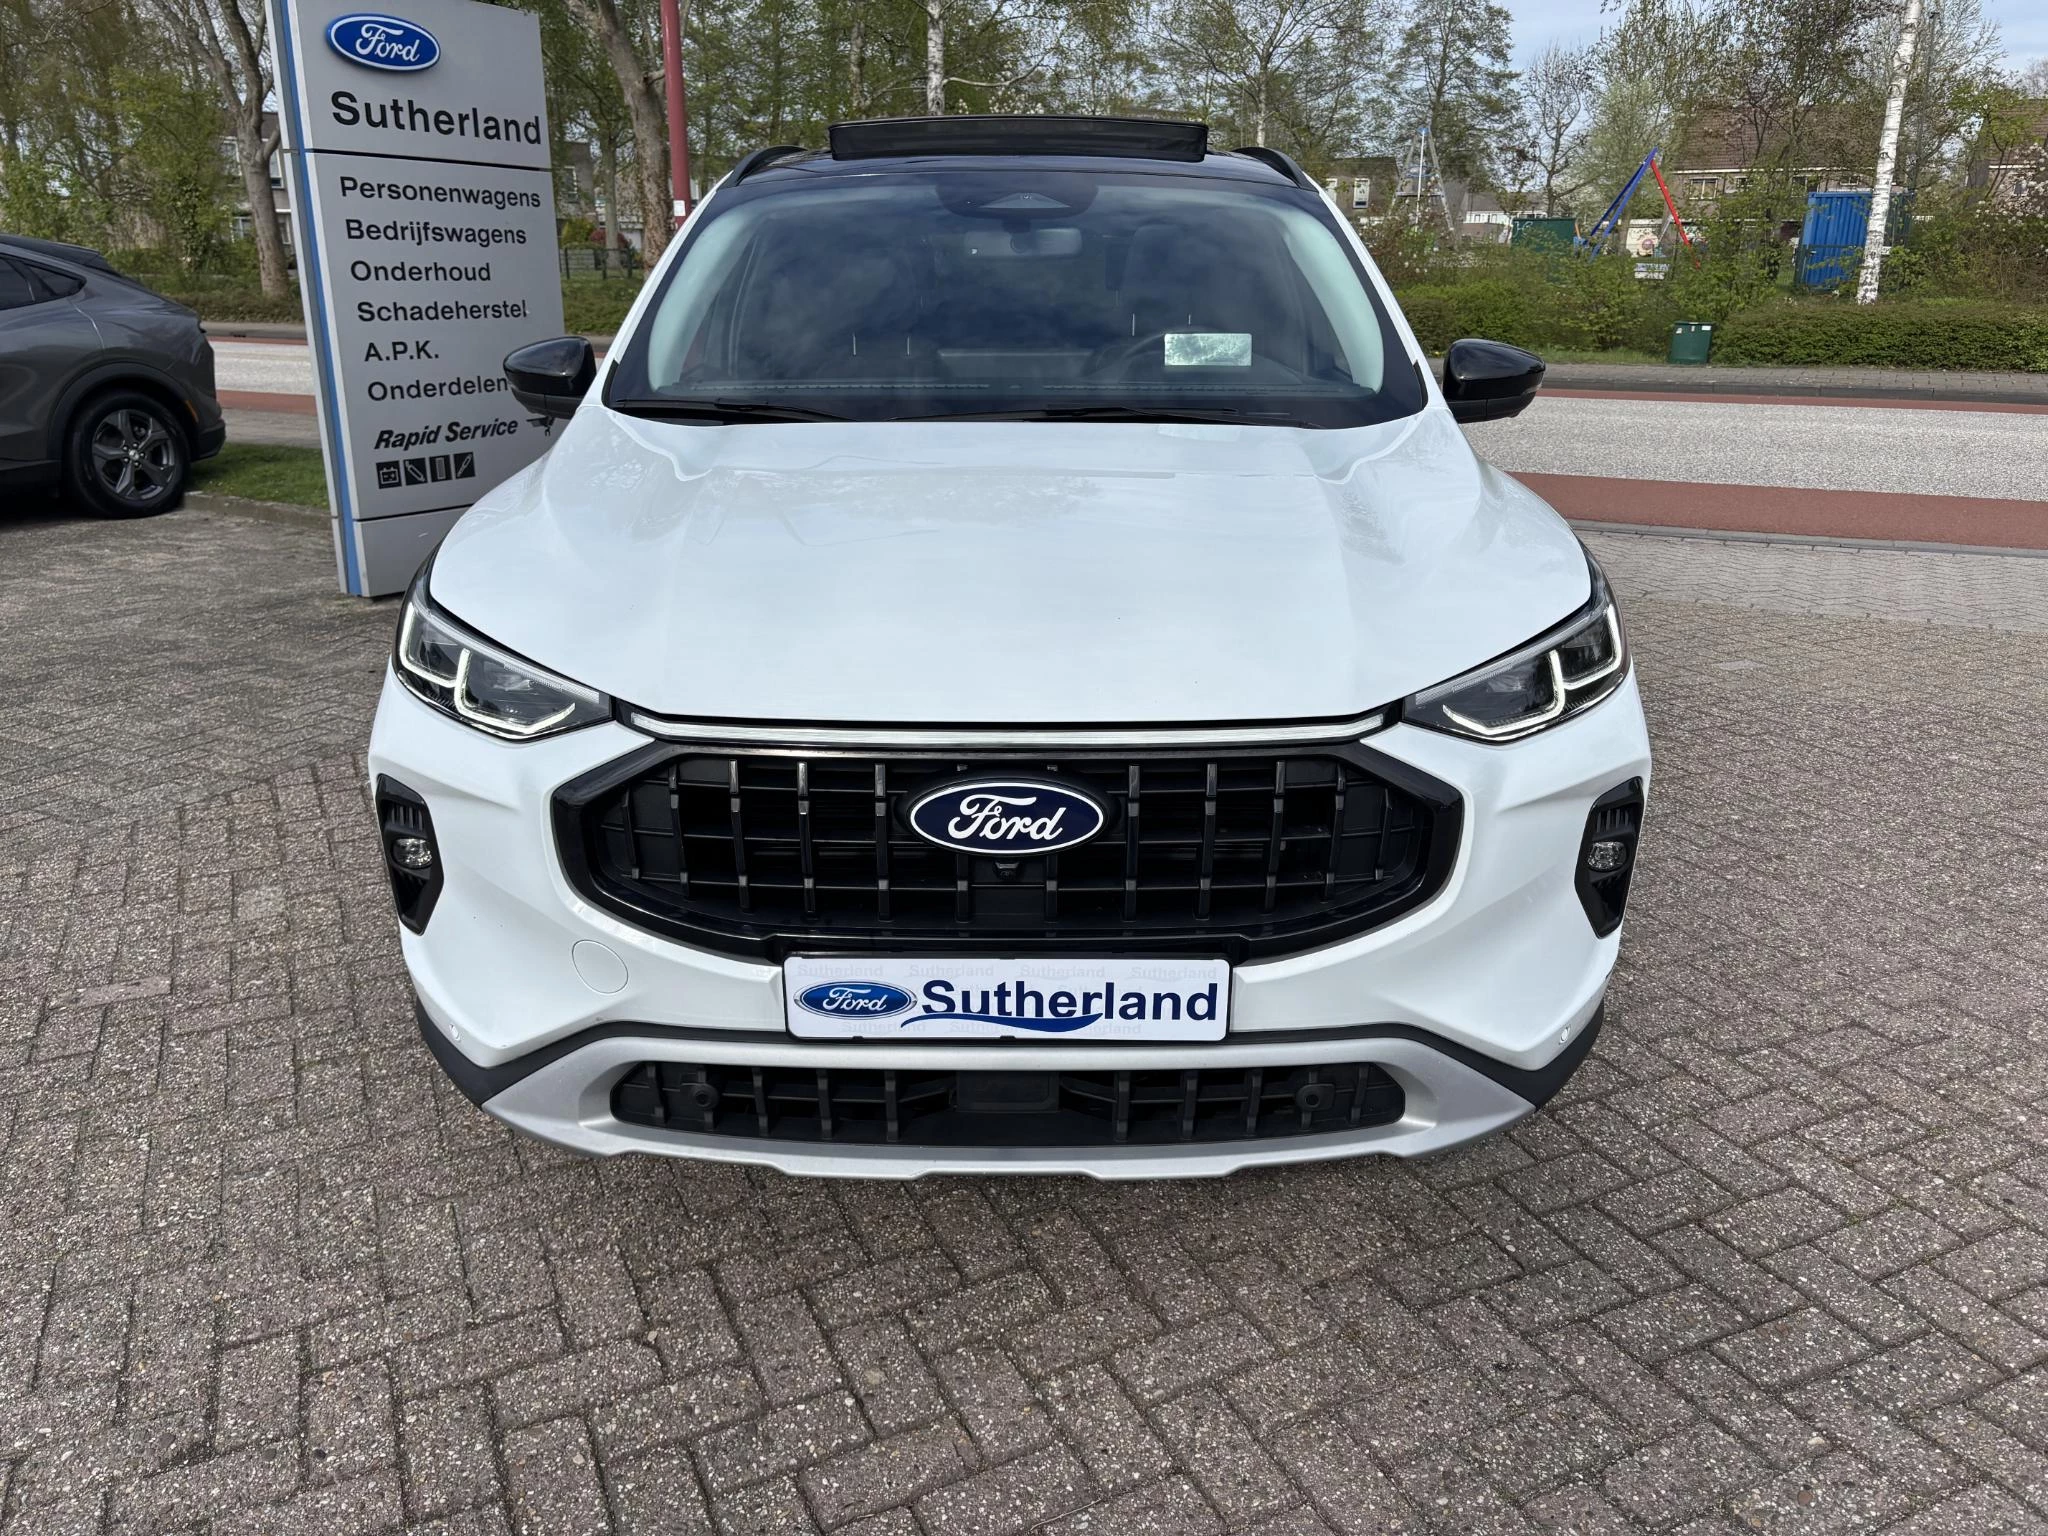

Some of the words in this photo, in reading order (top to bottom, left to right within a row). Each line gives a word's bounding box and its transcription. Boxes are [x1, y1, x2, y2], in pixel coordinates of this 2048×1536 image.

[355, 23, 420, 62] Ford
[330, 91, 542, 145] Sutherland
[340, 176, 541, 210] Personenwagens
[345, 218, 527, 247] Bedrijfswagens
[350, 260, 491, 281] Onderhoud
[357, 299, 528, 322] Schadeherstel
[364, 340, 440, 362] A.P.K.
[367, 375, 509, 401] Onderdelen
[374, 425, 441, 451] Rapid
[445, 417, 519, 443] Service
[947, 794, 1067, 840] Ford
[797, 964, 884, 977] Sutherland
[910, 965, 994, 977] Sutherland
[1019, 965, 1105, 977] Sutherland
[1130, 967, 1217, 978] Sutherland
[822, 987, 888, 1012] Ford
[922, 979, 1218, 1020] Sutherland
